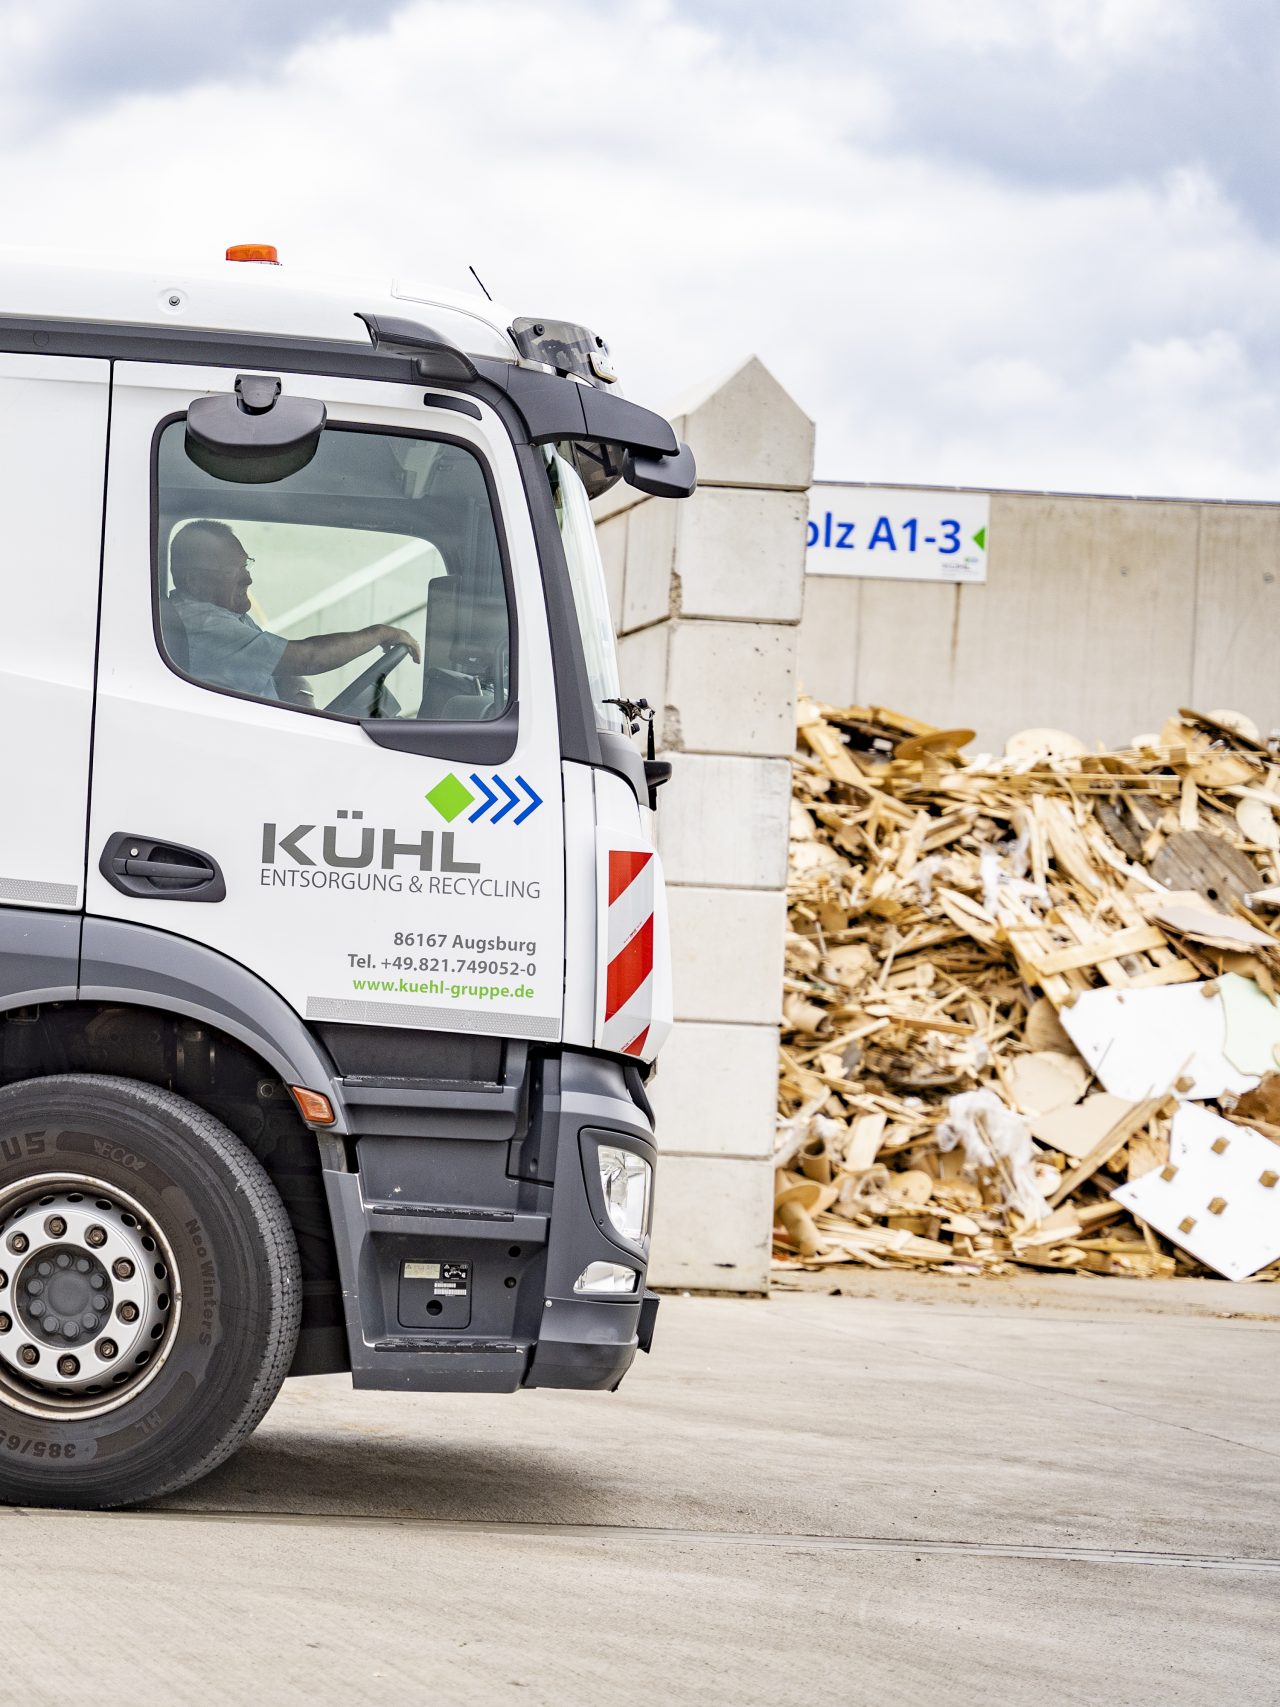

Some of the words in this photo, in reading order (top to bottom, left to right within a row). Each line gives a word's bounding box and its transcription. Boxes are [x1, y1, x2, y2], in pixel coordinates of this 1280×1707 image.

[868, 515, 961, 554] A1-3
[261, 809, 481, 874] KÜHL
[260, 868, 403, 893] ENTSORGUNG
[408, 875, 423, 893] &
[429, 876, 541, 899] RECYCLING
[393, 932, 447, 948] 86167
[452, 934, 537, 956] Augsburg
[348, 954, 376, 969] Tel.
[381, 956, 537, 976] +49.821.749052-0
[352, 979, 535, 999] www.kuehl-gruppe.de
